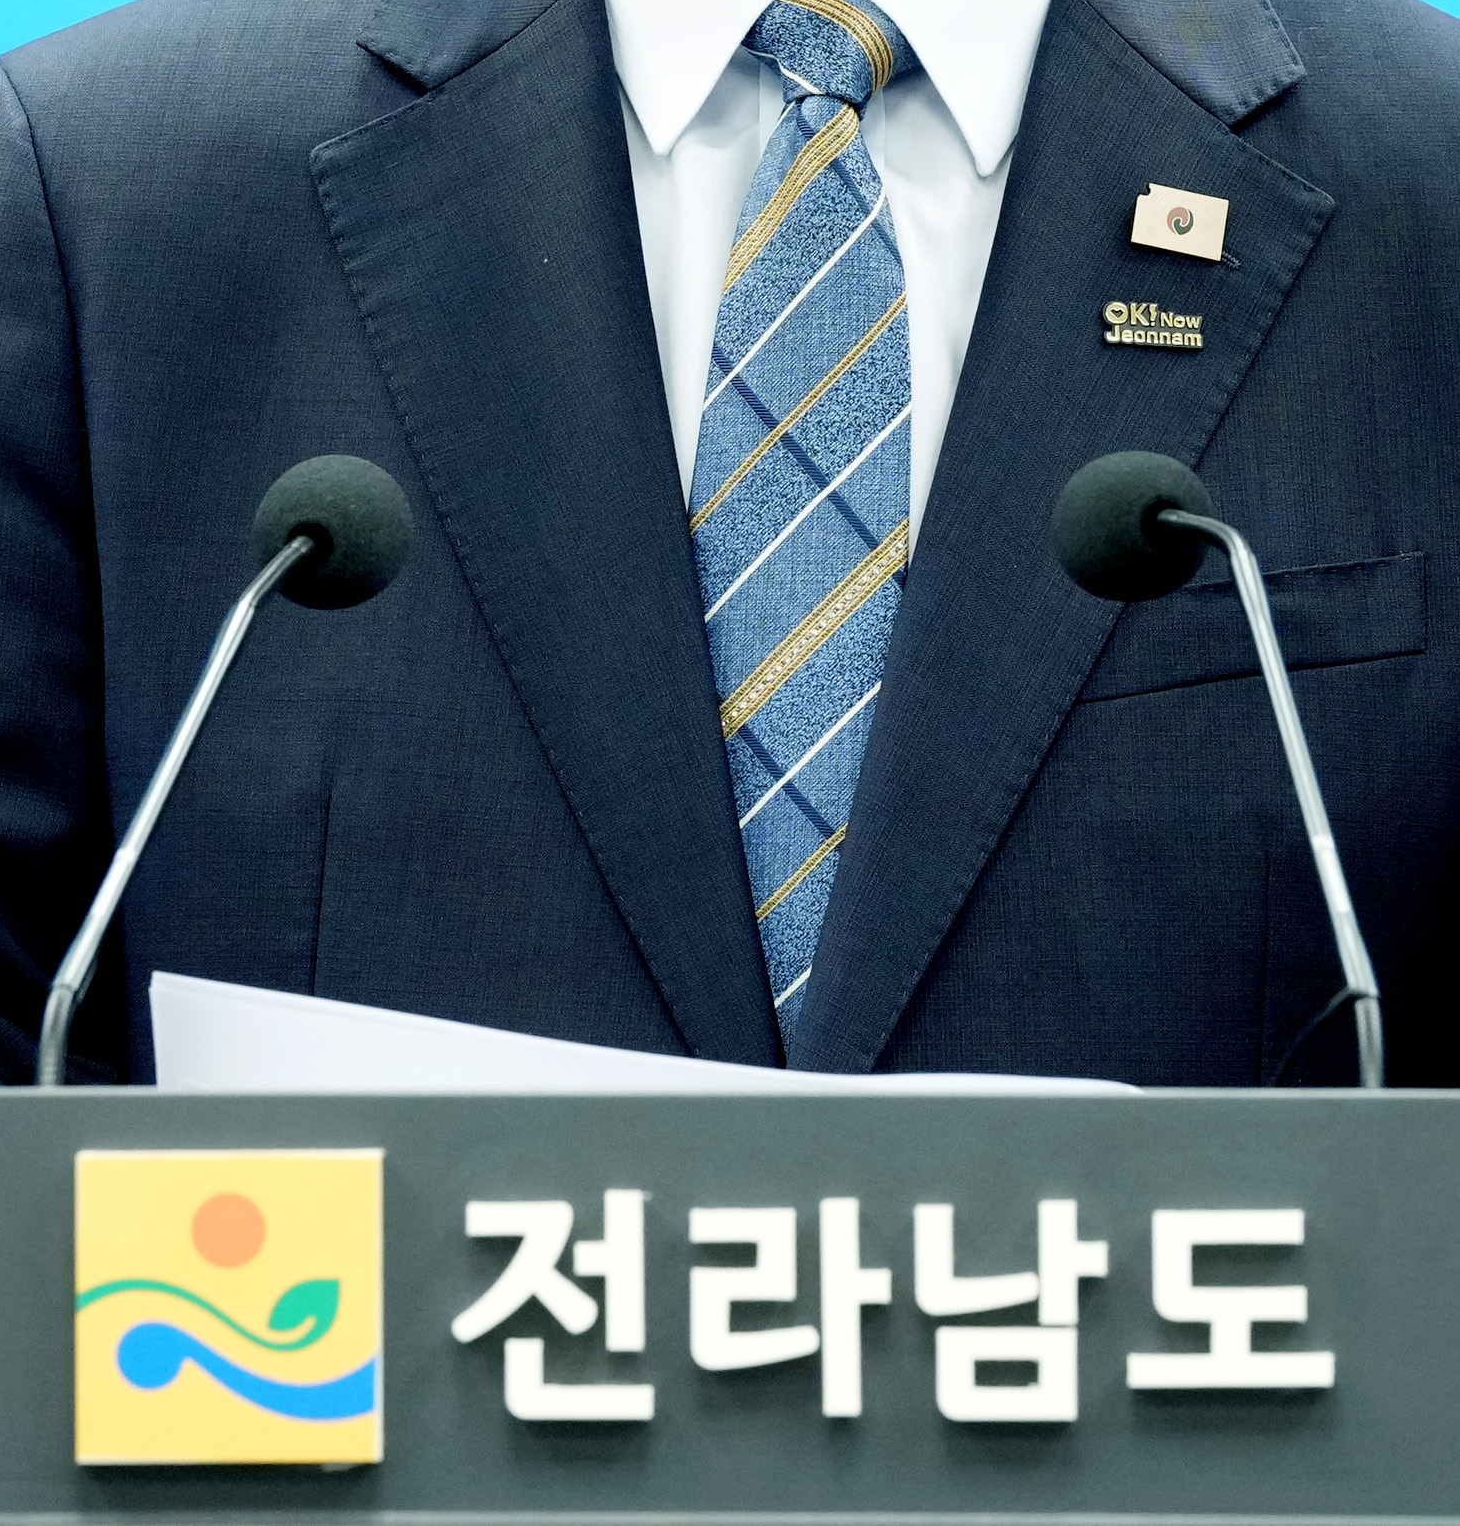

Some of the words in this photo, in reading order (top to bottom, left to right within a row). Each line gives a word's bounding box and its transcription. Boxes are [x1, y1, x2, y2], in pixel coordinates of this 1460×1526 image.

[1105, 301, 1158, 327] OK!
[1160, 311, 1200, 329] Now
[1105, 324, 1202, 347] Jeonnam
[450, 1188, 1336, 1424] 전라남도
